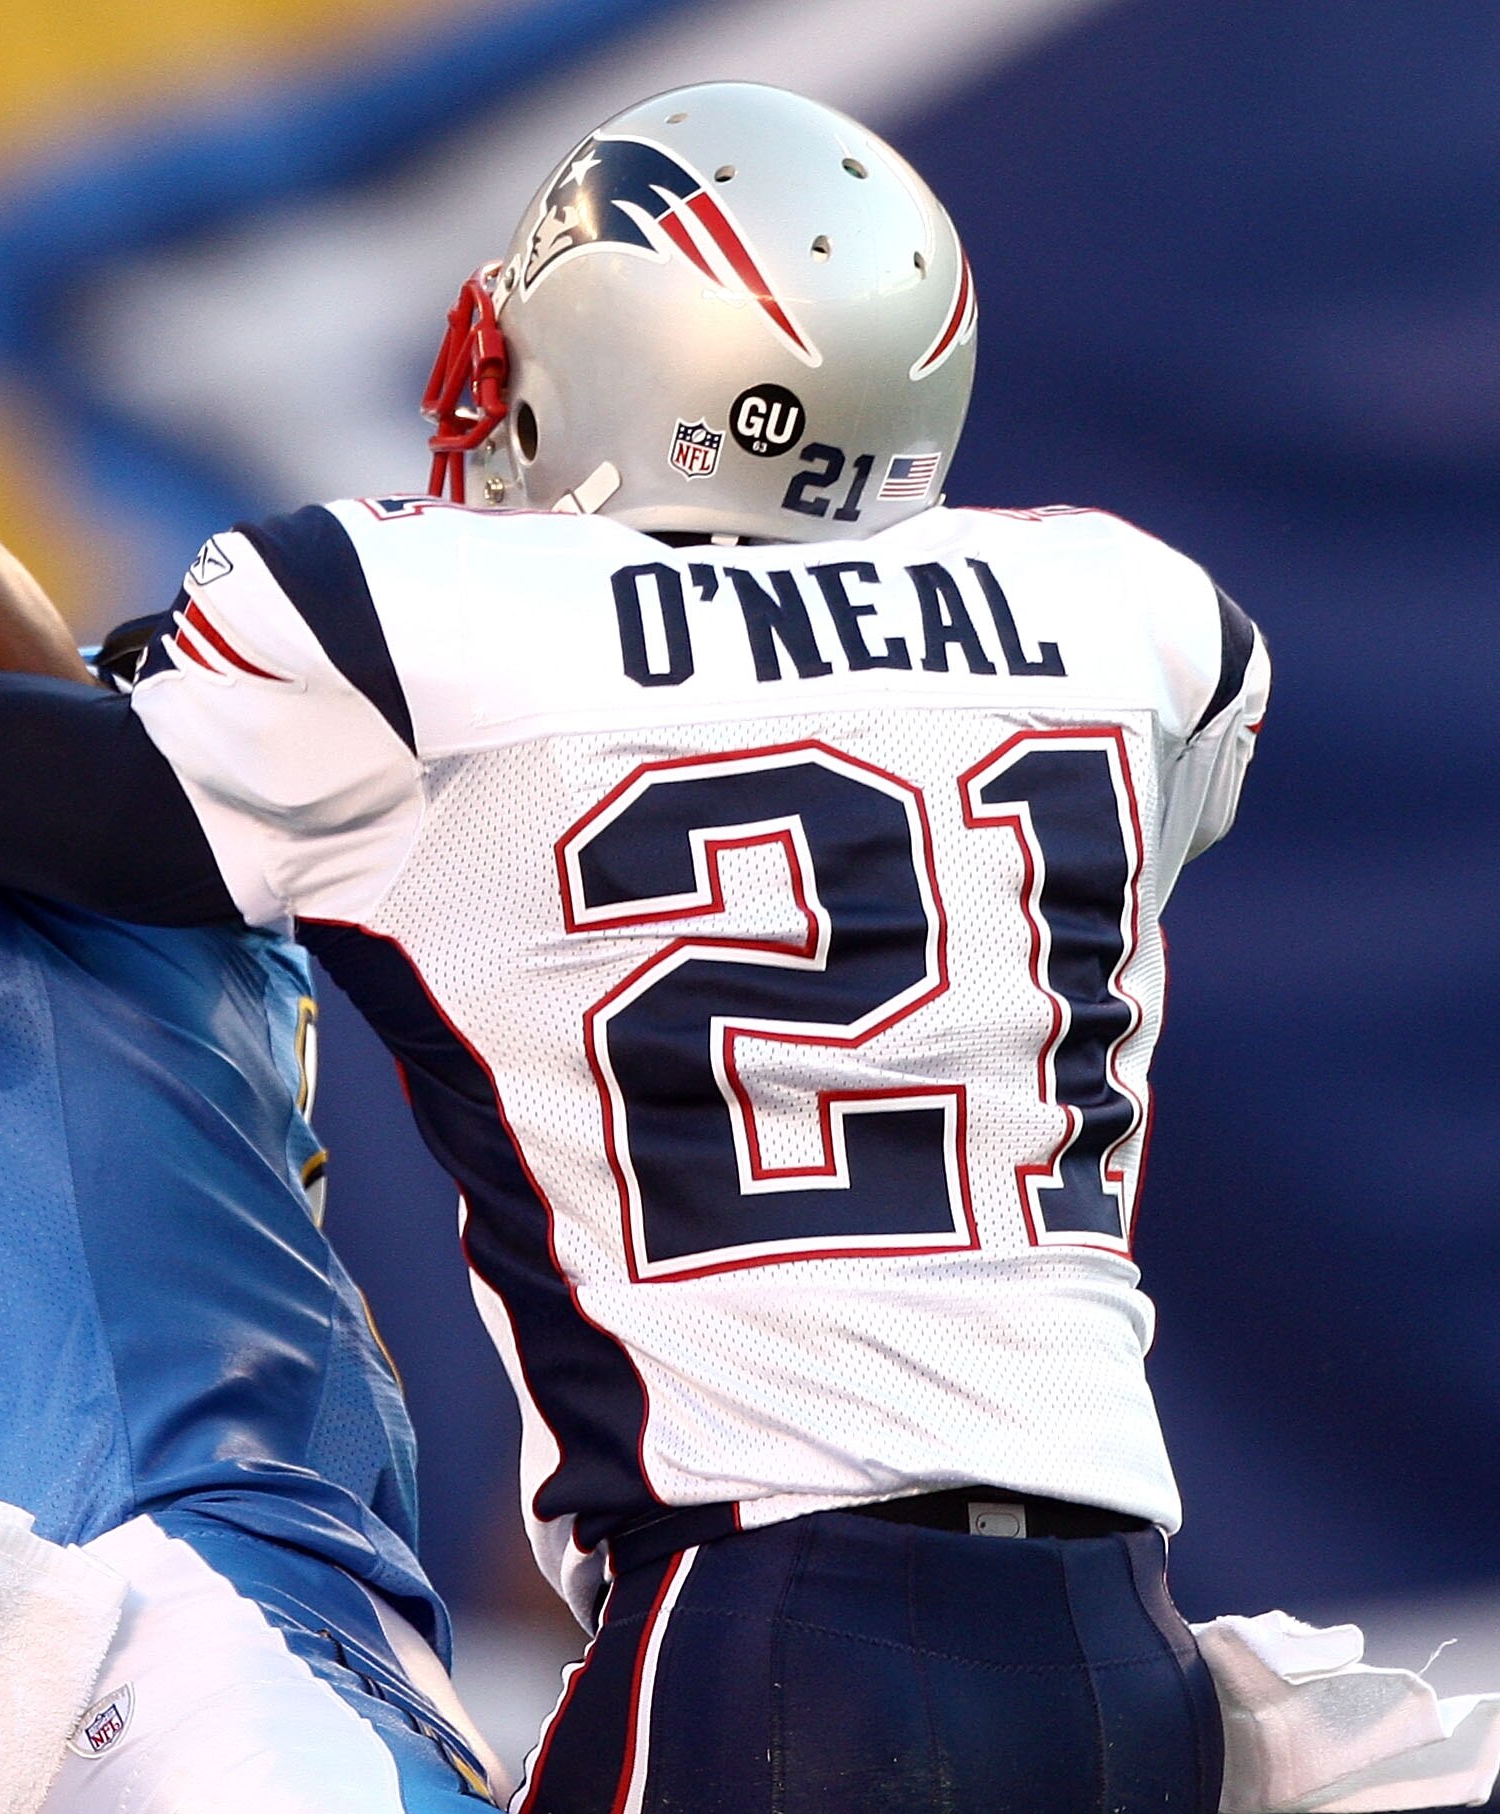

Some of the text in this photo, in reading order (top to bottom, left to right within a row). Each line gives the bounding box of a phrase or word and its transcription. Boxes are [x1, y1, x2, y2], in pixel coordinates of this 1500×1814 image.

[736, 396, 800, 445] GU
[673, 442, 712, 472] NFL
[752, 440, 768, 453] 63
[780, 441, 876, 522] 21
[609, 556, 1069, 688] O'NEAL
[553, 726, 1145, 1284] 21
[90, 1719, 121, 1748] NFL
